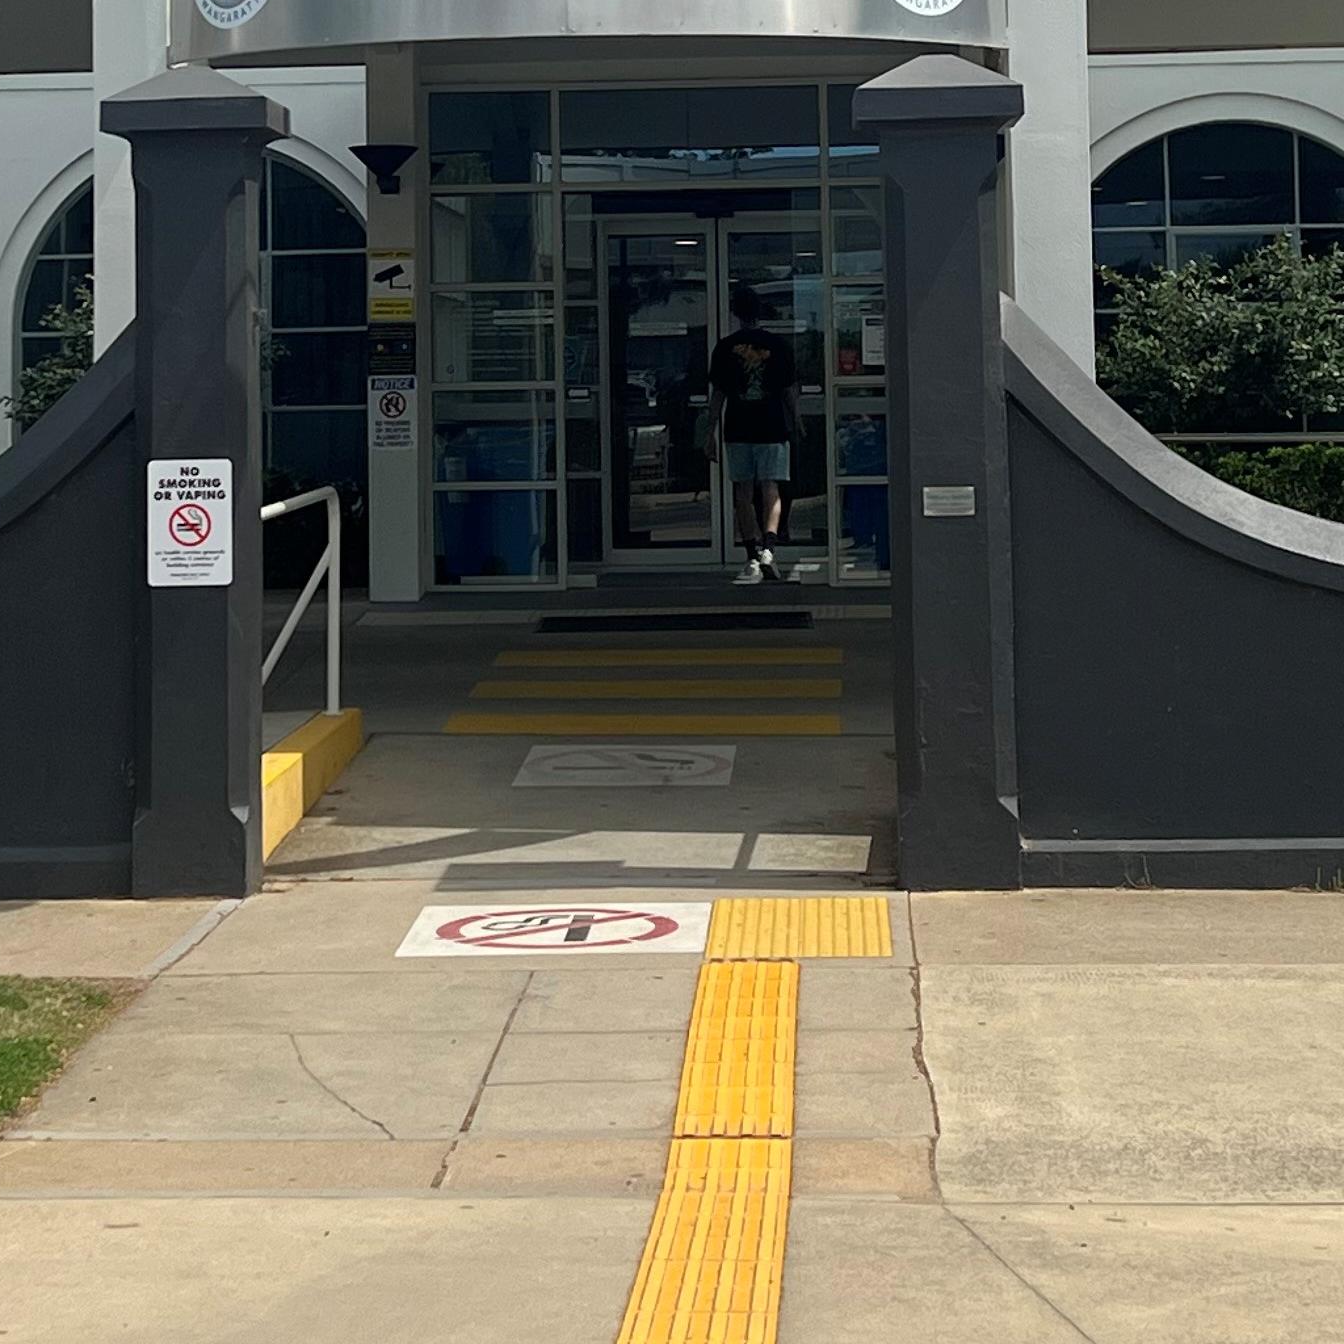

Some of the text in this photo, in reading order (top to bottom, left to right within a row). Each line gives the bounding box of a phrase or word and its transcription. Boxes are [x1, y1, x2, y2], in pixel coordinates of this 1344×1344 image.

[374, 379, 411, 389] NOTICE
[180, 466, 200, 476] NO
[158, 478, 221, 489] SMOKING
[154, 490, 226, 501] OR VAPING
